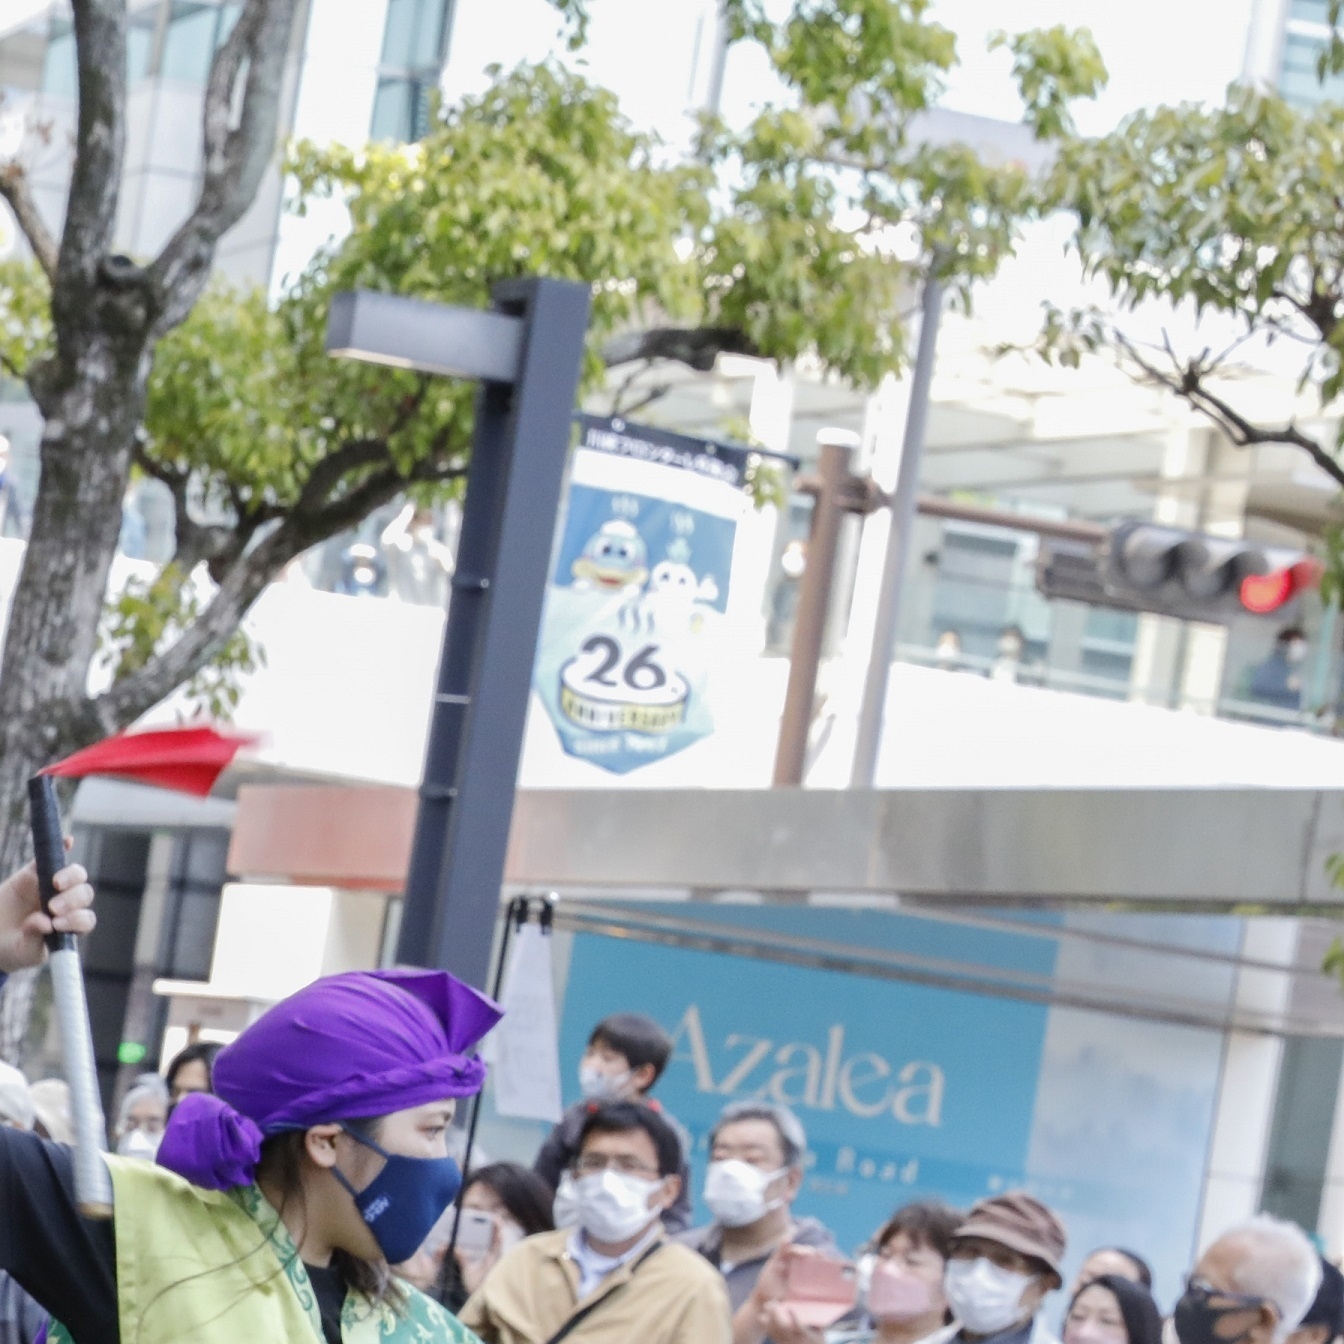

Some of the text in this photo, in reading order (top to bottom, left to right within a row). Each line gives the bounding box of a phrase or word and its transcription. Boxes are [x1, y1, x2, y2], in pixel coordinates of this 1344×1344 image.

[582, 635, 666, 690] 26
[671, 1003, 945, 1128] Azalea
[836, 1146, 918, 1184] Road
